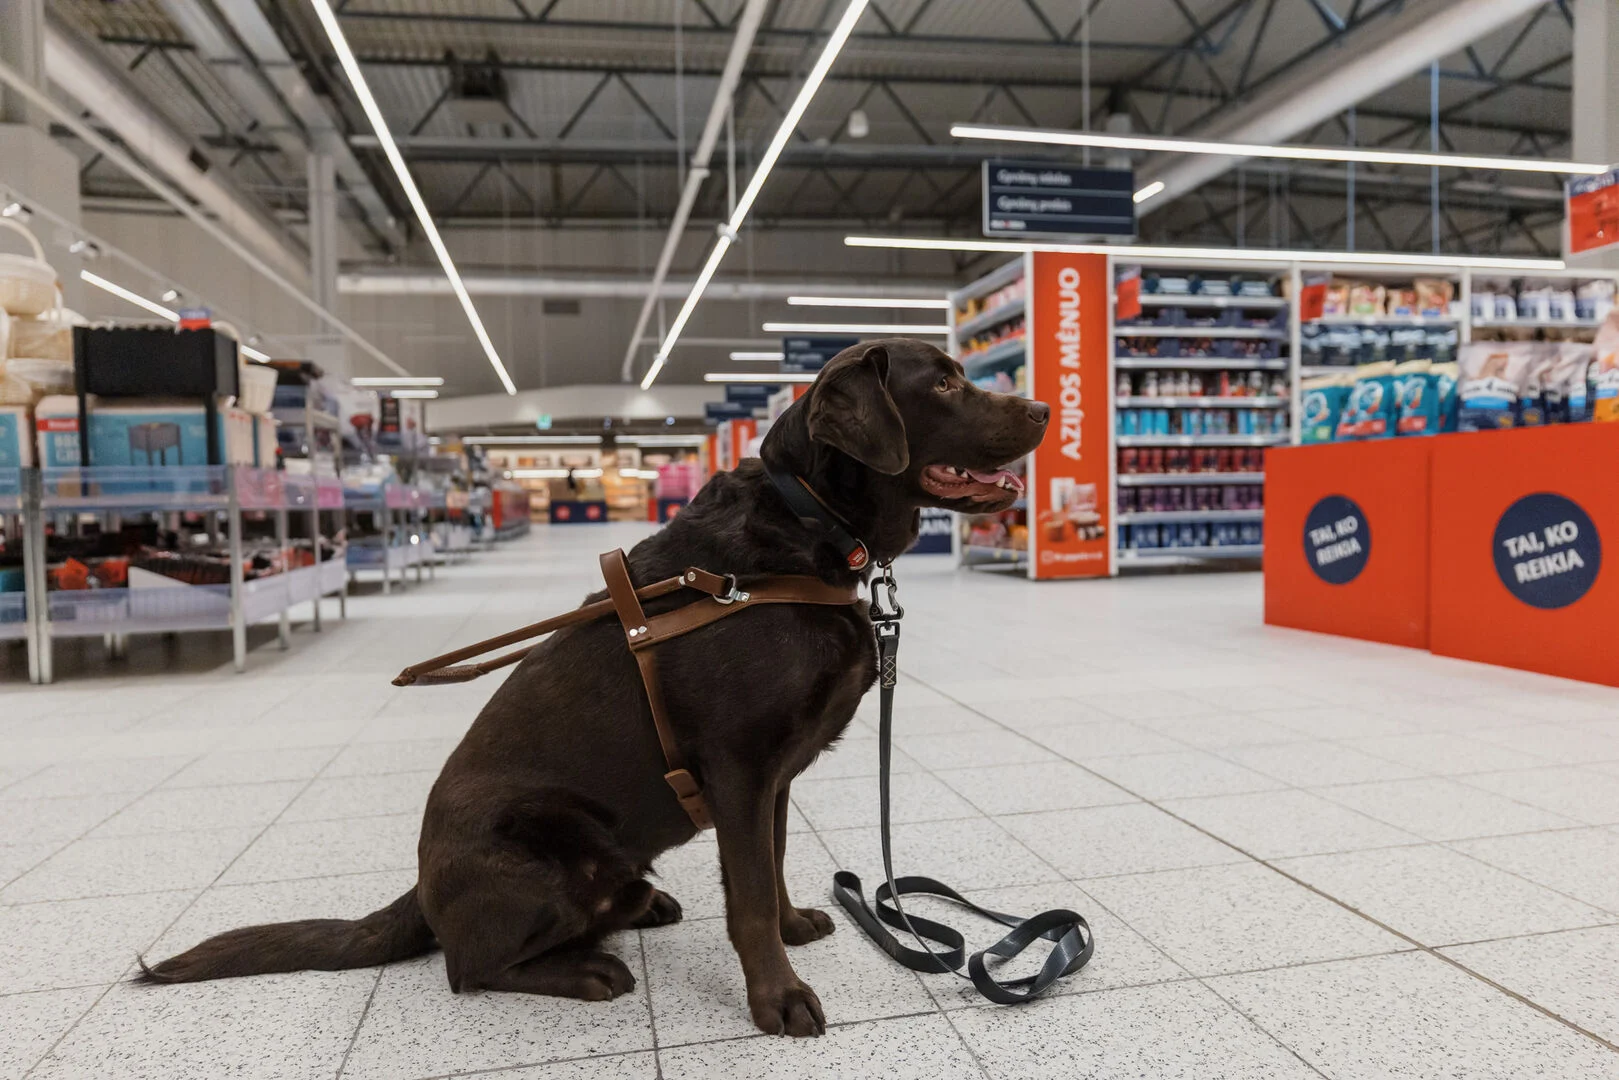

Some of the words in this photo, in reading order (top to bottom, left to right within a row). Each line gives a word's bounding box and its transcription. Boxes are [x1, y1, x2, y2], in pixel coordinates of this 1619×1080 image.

[1055, 267, 1081, 369] MĖNUO
[1060, 373, 1083, 460] AZIJOS
[1310, 525, 1337, 547] TAI,
[1335, 515, 1358, 538] KO
[1503, 532, 1545, 557] TAI,
[1543, 520, 1579, 547] KO
[1316, 538, 1361, 566] REIKIA
[1514, 548, 1584, 583] REIKIA
